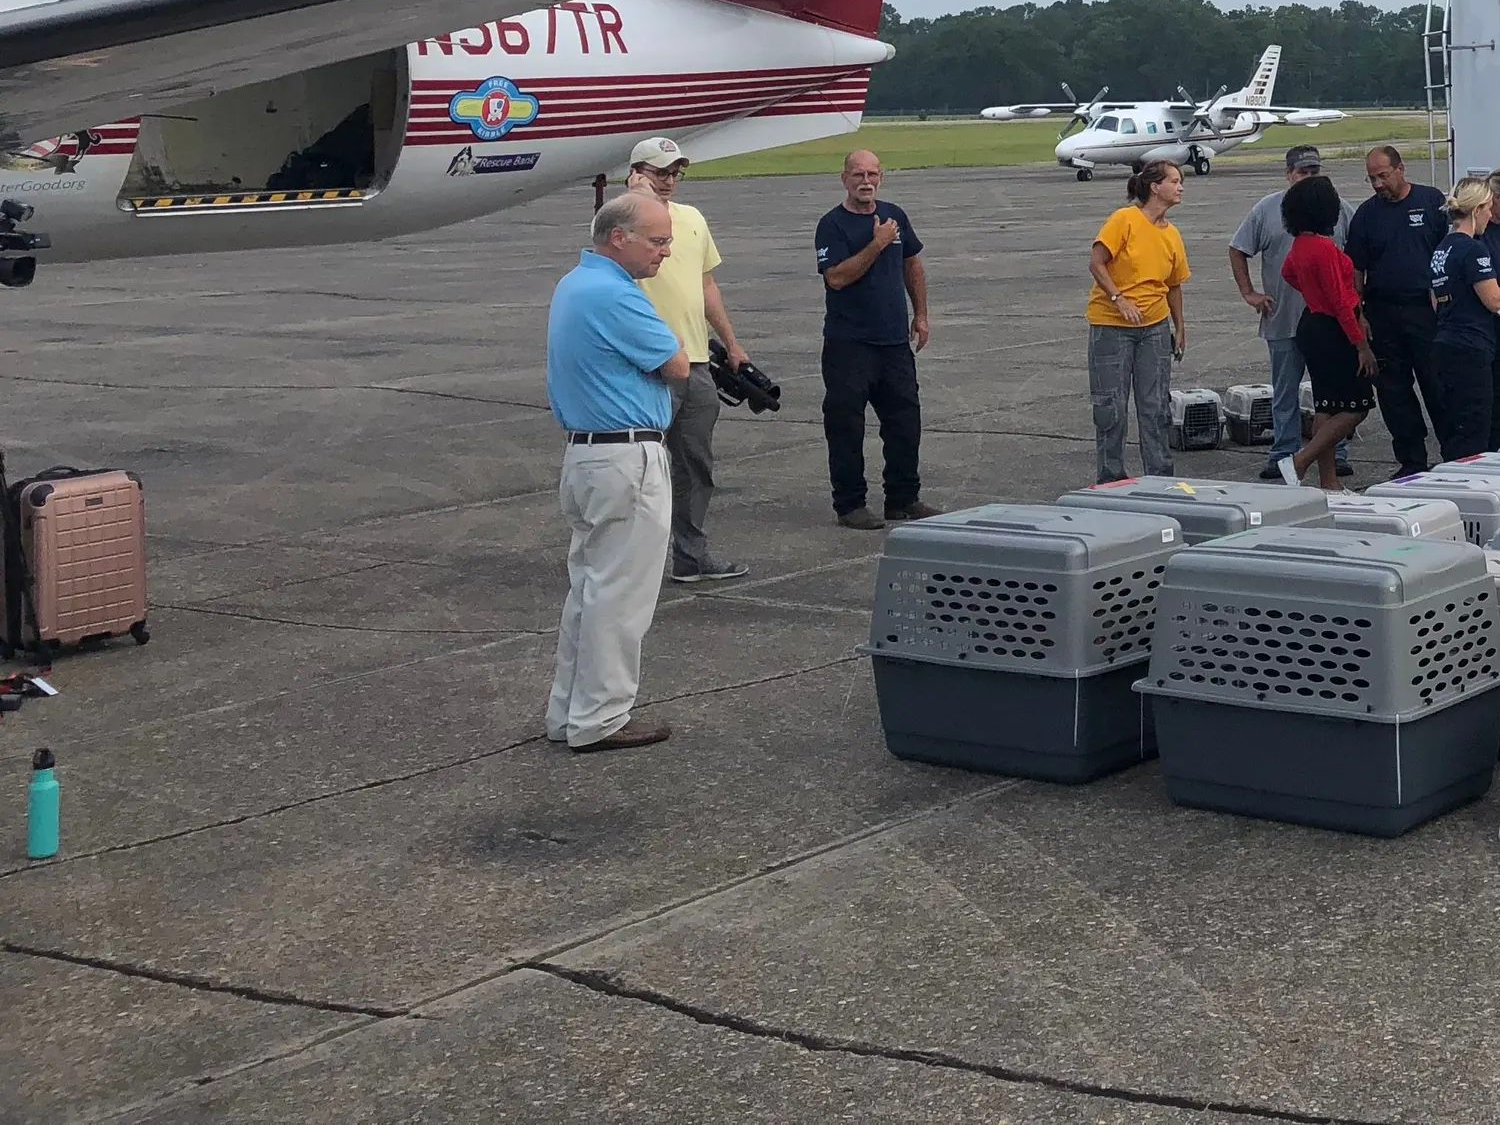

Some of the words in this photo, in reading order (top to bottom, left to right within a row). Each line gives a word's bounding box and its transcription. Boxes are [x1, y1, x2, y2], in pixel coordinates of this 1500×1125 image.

[488, 79, 509, 89] FREE
[480, 157, 513, 168] Rescue
[513, 155, 535, 166] Bank
